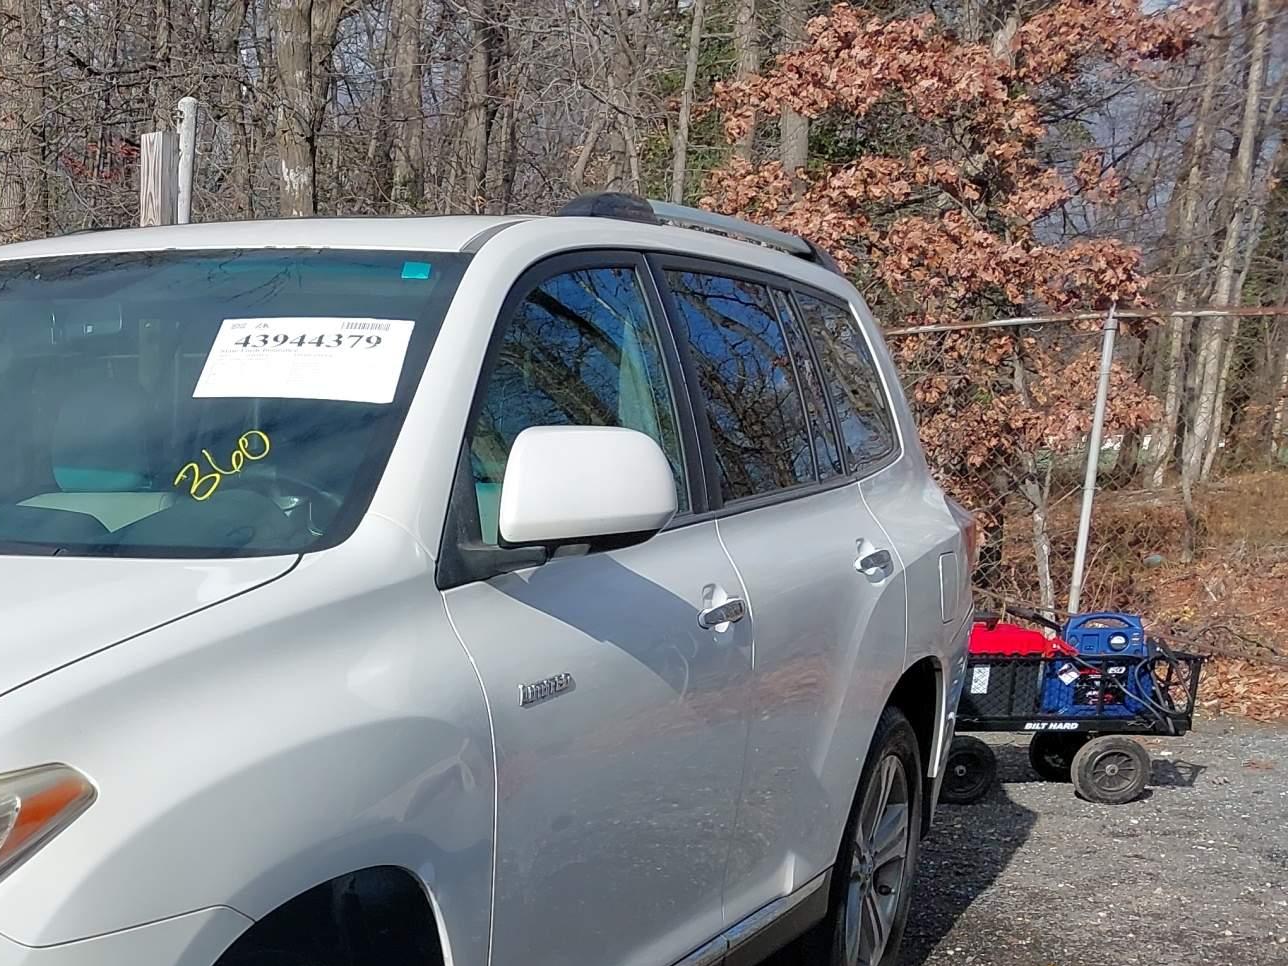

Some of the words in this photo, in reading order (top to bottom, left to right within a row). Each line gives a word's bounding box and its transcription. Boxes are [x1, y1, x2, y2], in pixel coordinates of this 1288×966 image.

[234, 333, 383, 349] 43944379
[1024, 722, 1046, 730] BILT
[1048, 722, 1079, 730] HARD
